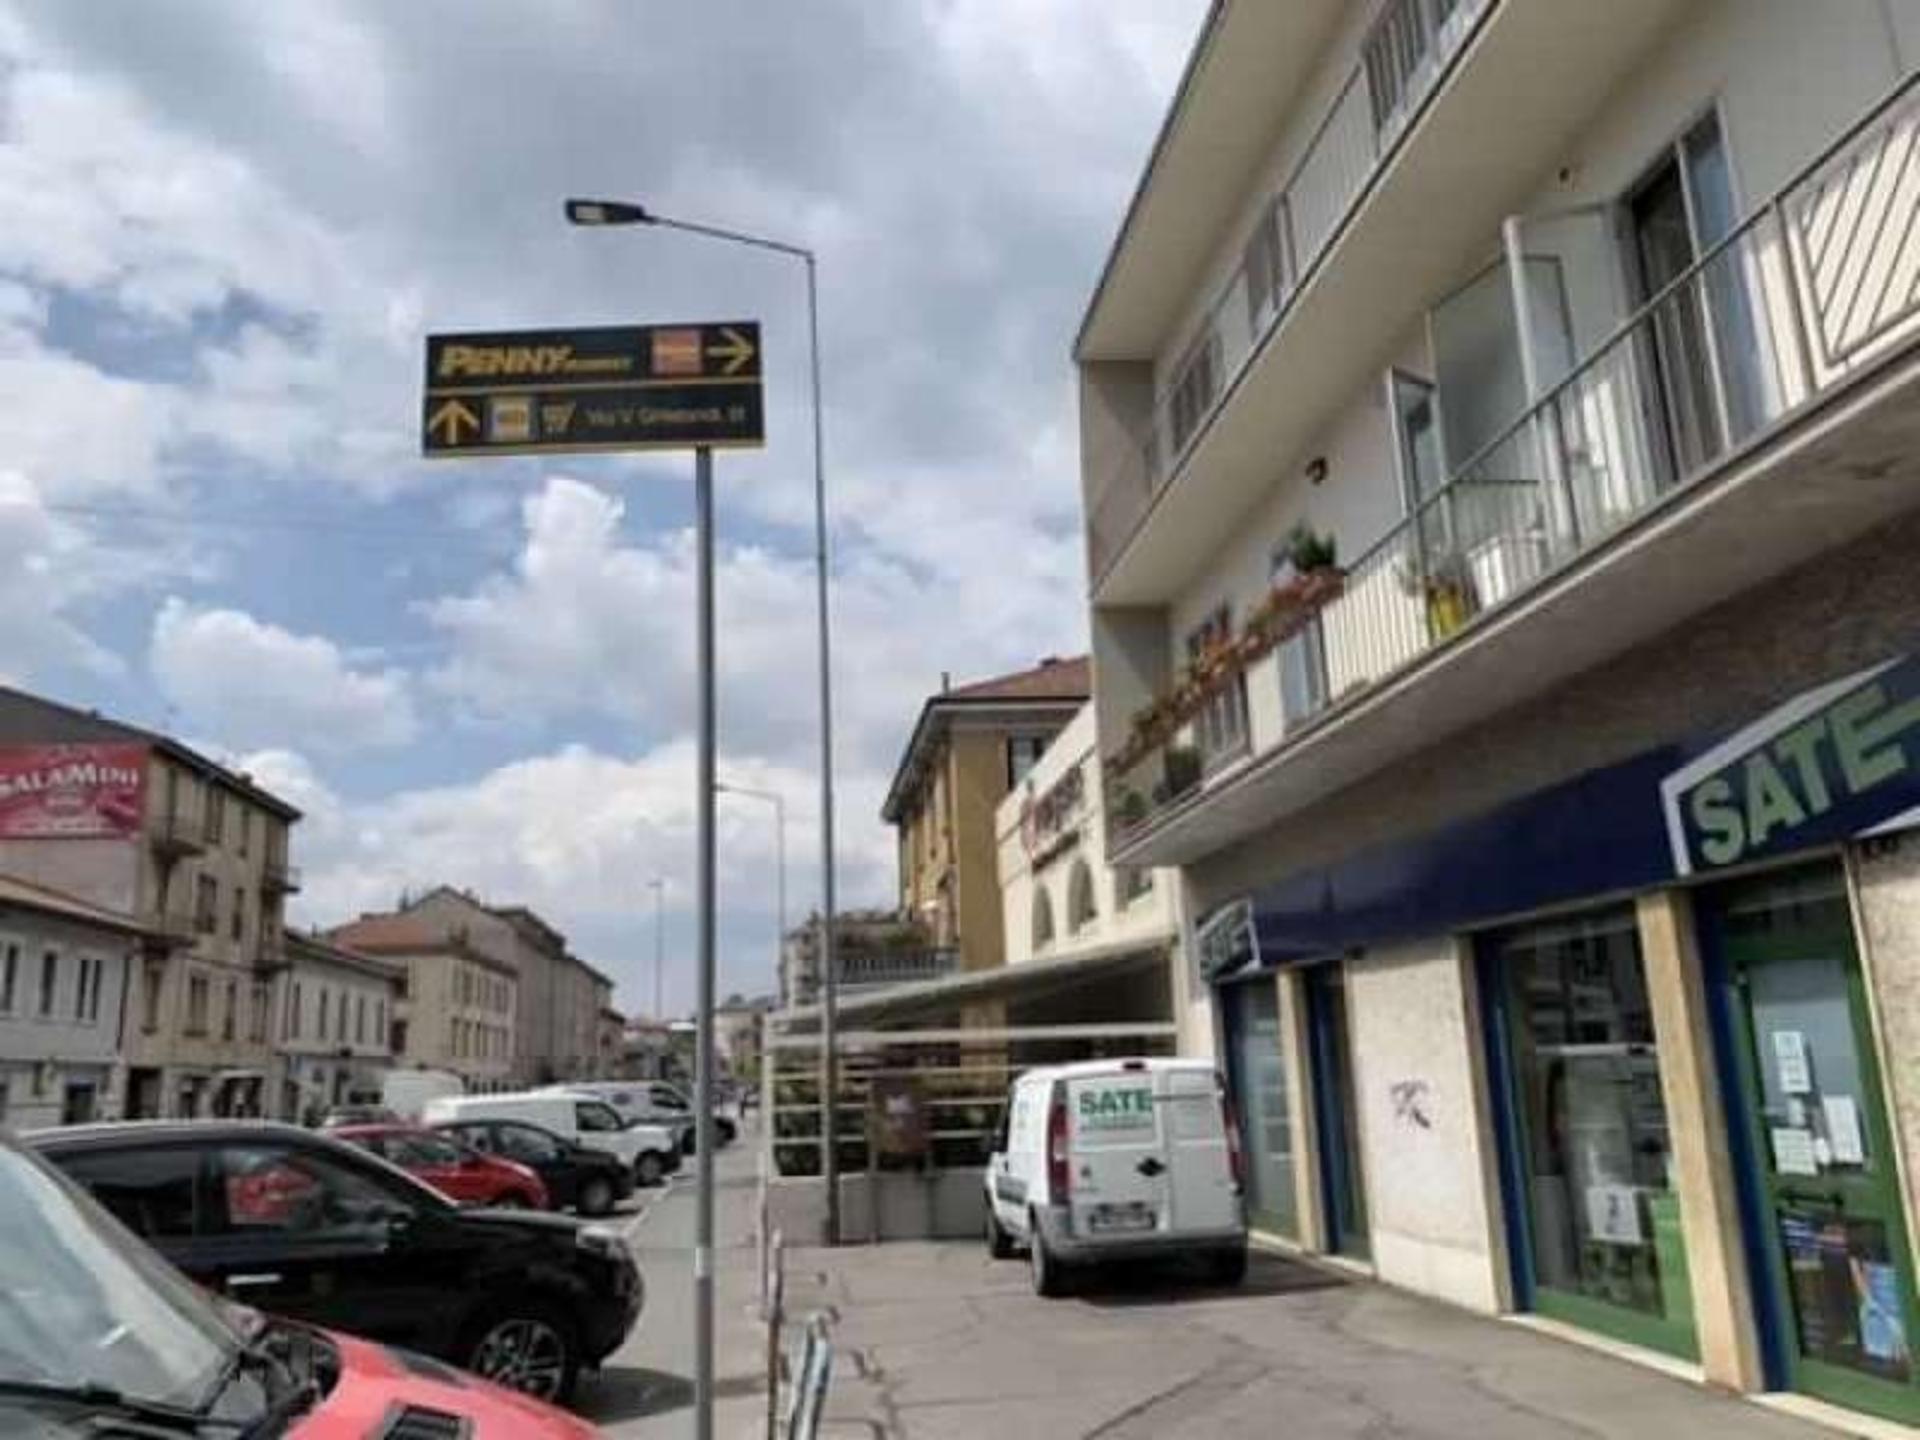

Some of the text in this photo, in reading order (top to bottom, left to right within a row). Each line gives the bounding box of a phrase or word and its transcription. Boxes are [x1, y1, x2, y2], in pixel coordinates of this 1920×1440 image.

[438, 345, 574, 377] PENNY
[1691, 682, 1920, 865] SATE
[1079, 1088, 1153, 1115] SATE
